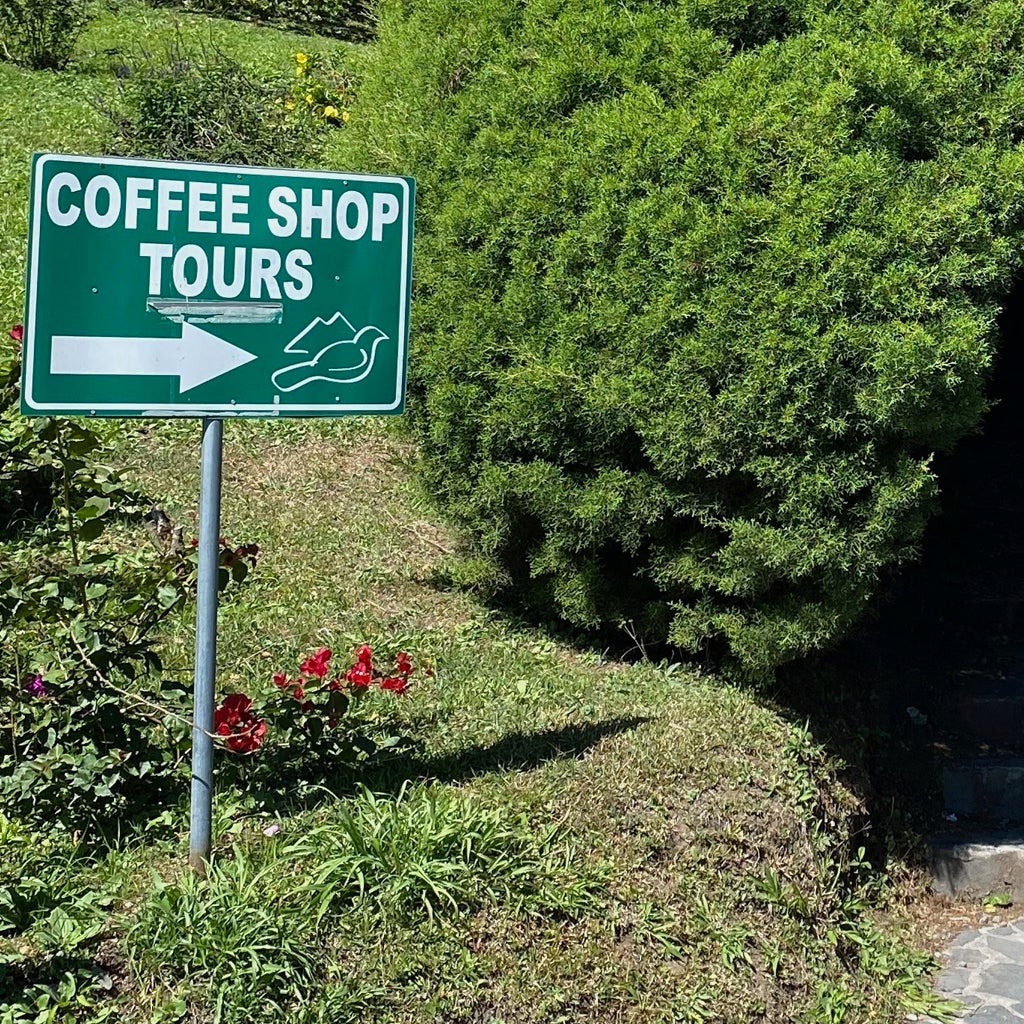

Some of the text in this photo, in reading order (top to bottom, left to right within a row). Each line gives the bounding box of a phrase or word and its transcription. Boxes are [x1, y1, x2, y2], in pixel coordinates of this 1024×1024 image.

[46, 172, 399, 242] COFFEE SHOP
[139, 243, 313, 301] TOURS
